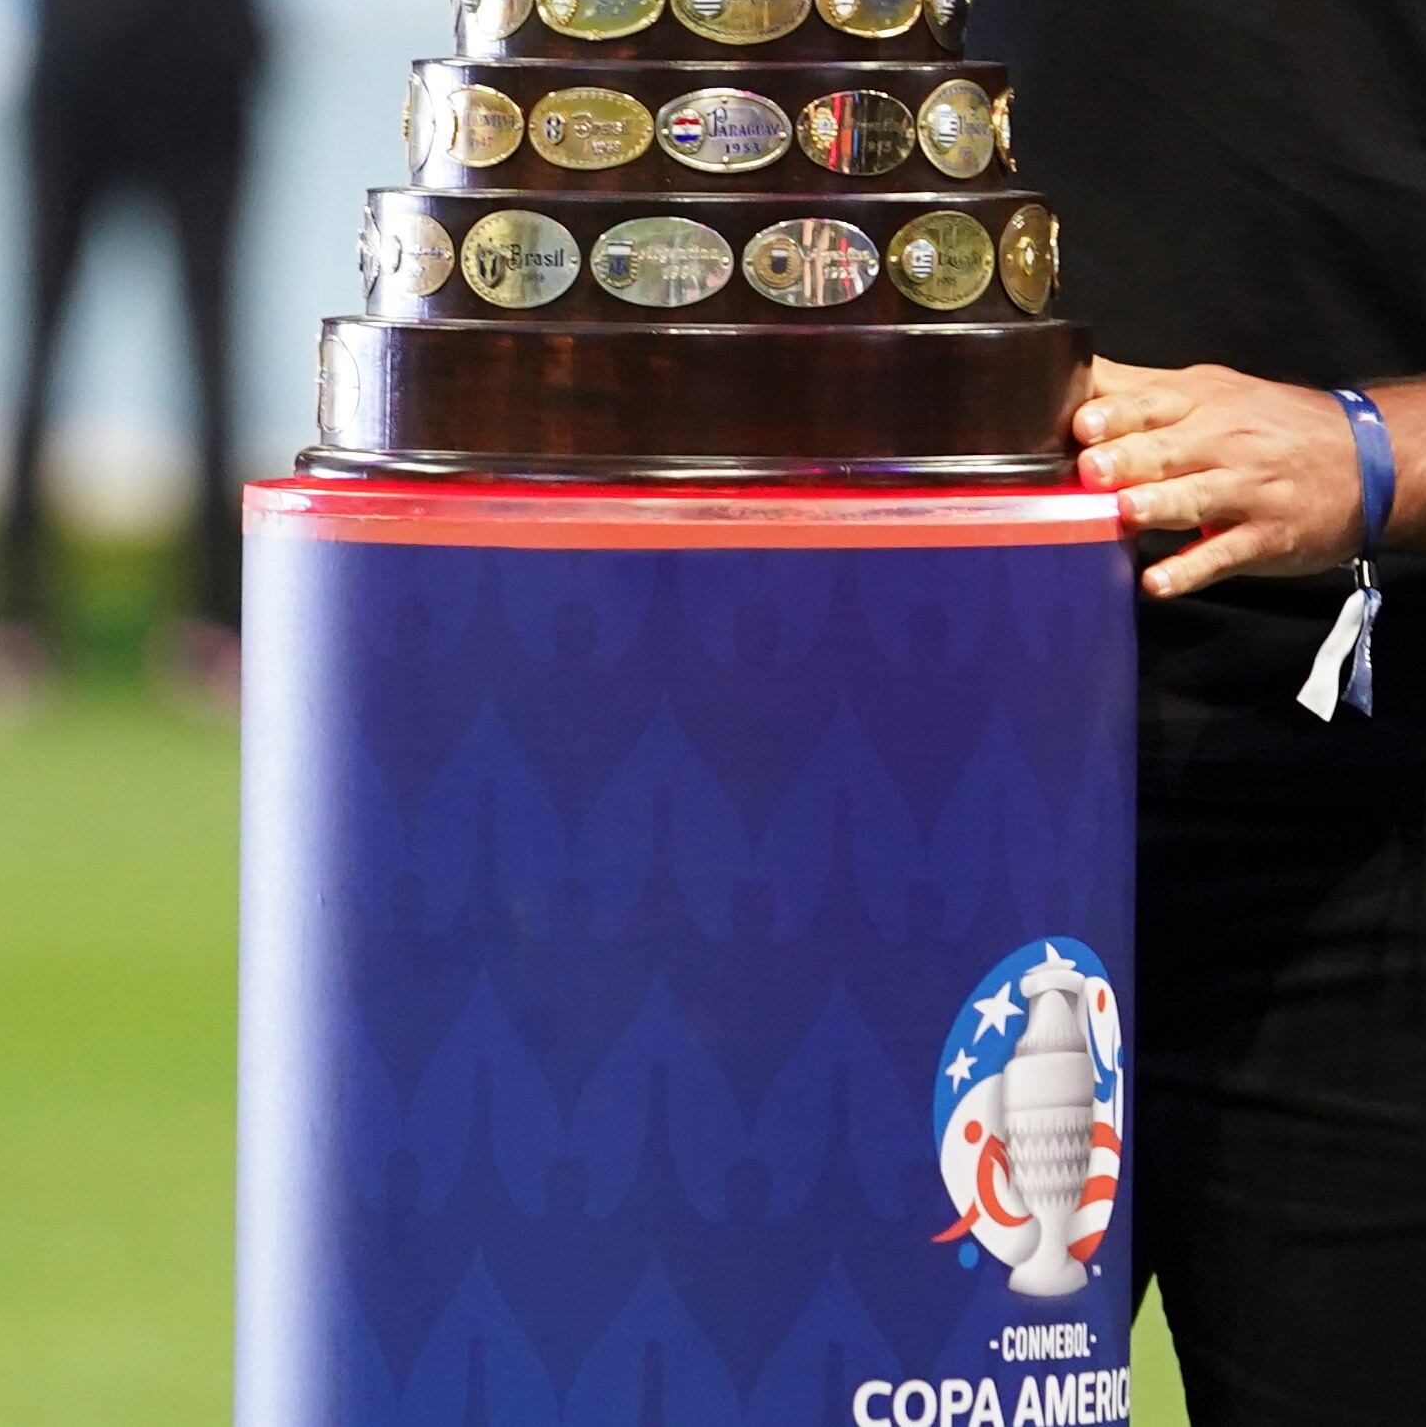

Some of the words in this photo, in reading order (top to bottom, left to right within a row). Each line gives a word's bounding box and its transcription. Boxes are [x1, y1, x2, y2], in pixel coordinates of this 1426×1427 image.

[724, 143, 761, 155] 1953
[504, 243, 565, 270] Brasil
[853, 1377, 1006, 1427] COPA
[1012, 1365, 1131, 1427] AMERIC
